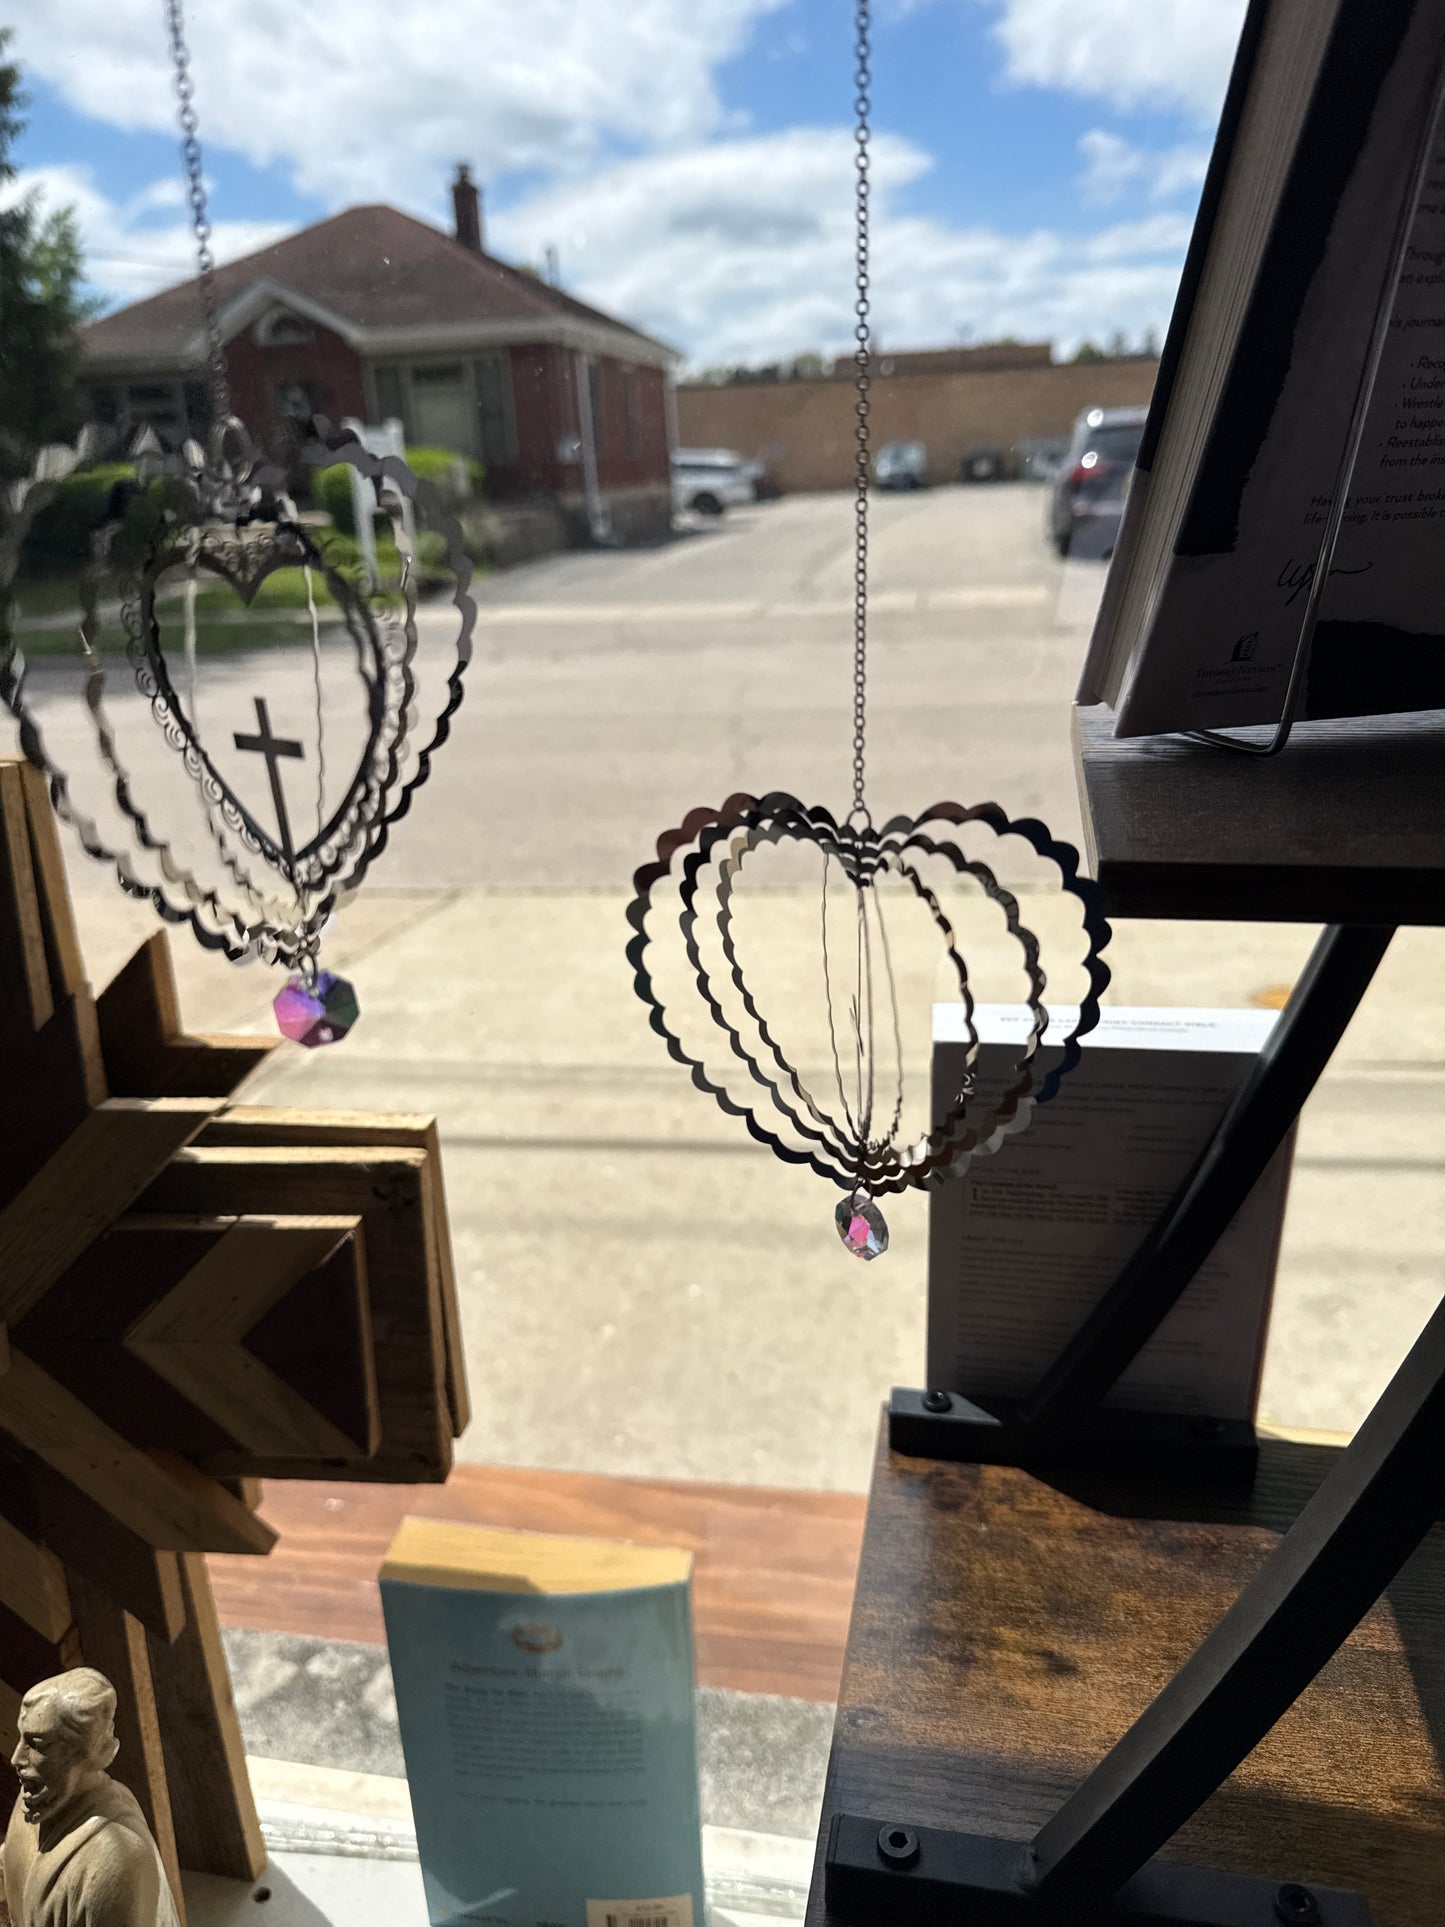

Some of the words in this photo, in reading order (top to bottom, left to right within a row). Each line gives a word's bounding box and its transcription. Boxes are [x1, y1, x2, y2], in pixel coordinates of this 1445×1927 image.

[1396, 420, 1407, 429] to
[1380, 454, 1407, 467] from
[1410, 453, 1428, 466] the
[1354, 496, 1381, 508] your
[1385, 493, 1413, 503] trust
[1371, 510, 1381, 520] It
[1382, 510, 1391, 520] is
[1392, 506, 1438, 522] possible
